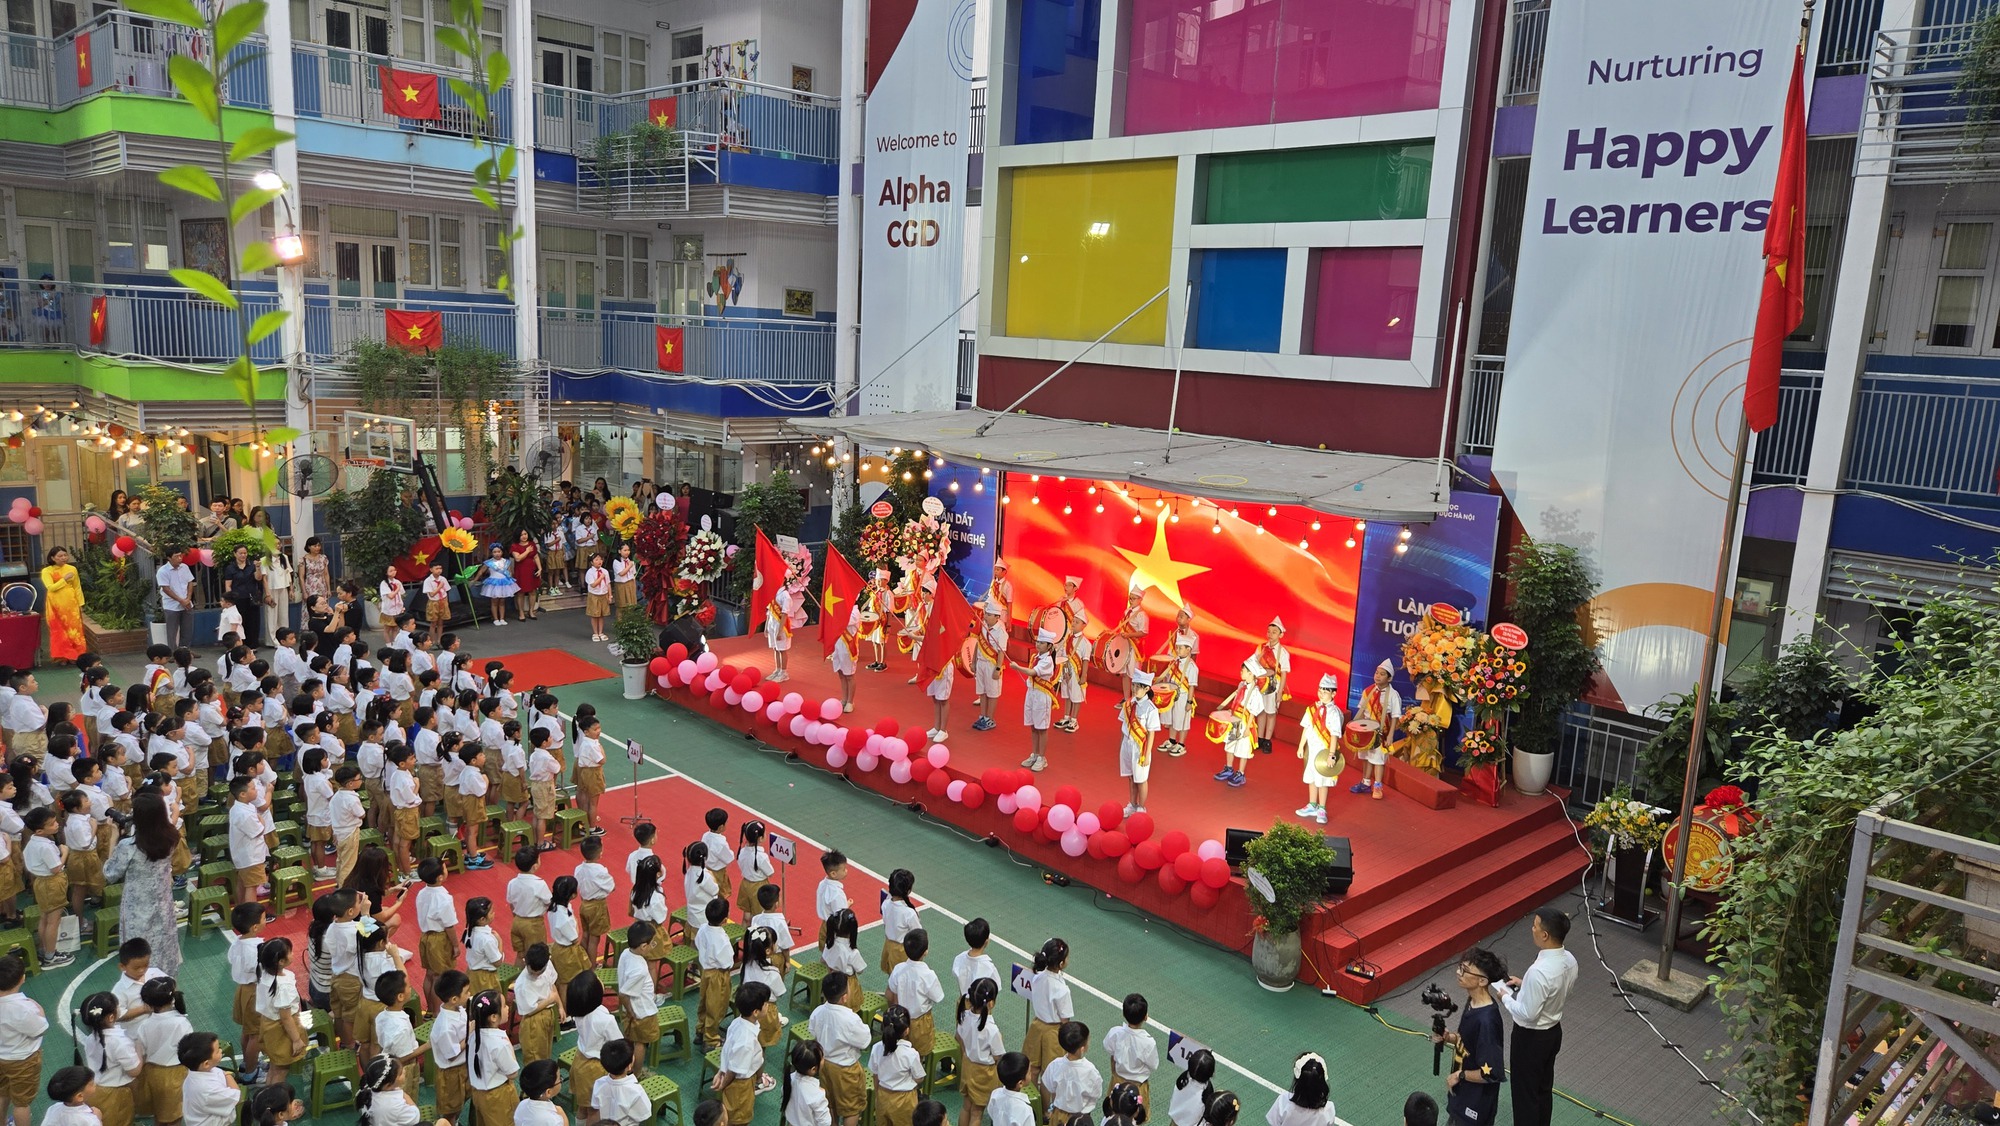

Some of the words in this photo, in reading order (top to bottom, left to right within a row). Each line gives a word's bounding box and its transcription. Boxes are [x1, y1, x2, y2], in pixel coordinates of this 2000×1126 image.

[1587, 44, 1764, 85] Nurturing
[876, 134, 940, 153] Welcome
[943, 130, 957, 146] to
[1563, 125, 1774, 179] Happy
[878, 174, 951, 211] Alpha
[1542, 198, 1773, 234] Learners
[886, 219, 940, 248] CGD
[955, 511, 974, 527] DẤT
[960, 531, 986, 549] NGHỆ
[1397, 597, 1432, 617] LÀM
[775, 843, 790, 857] 1A4
